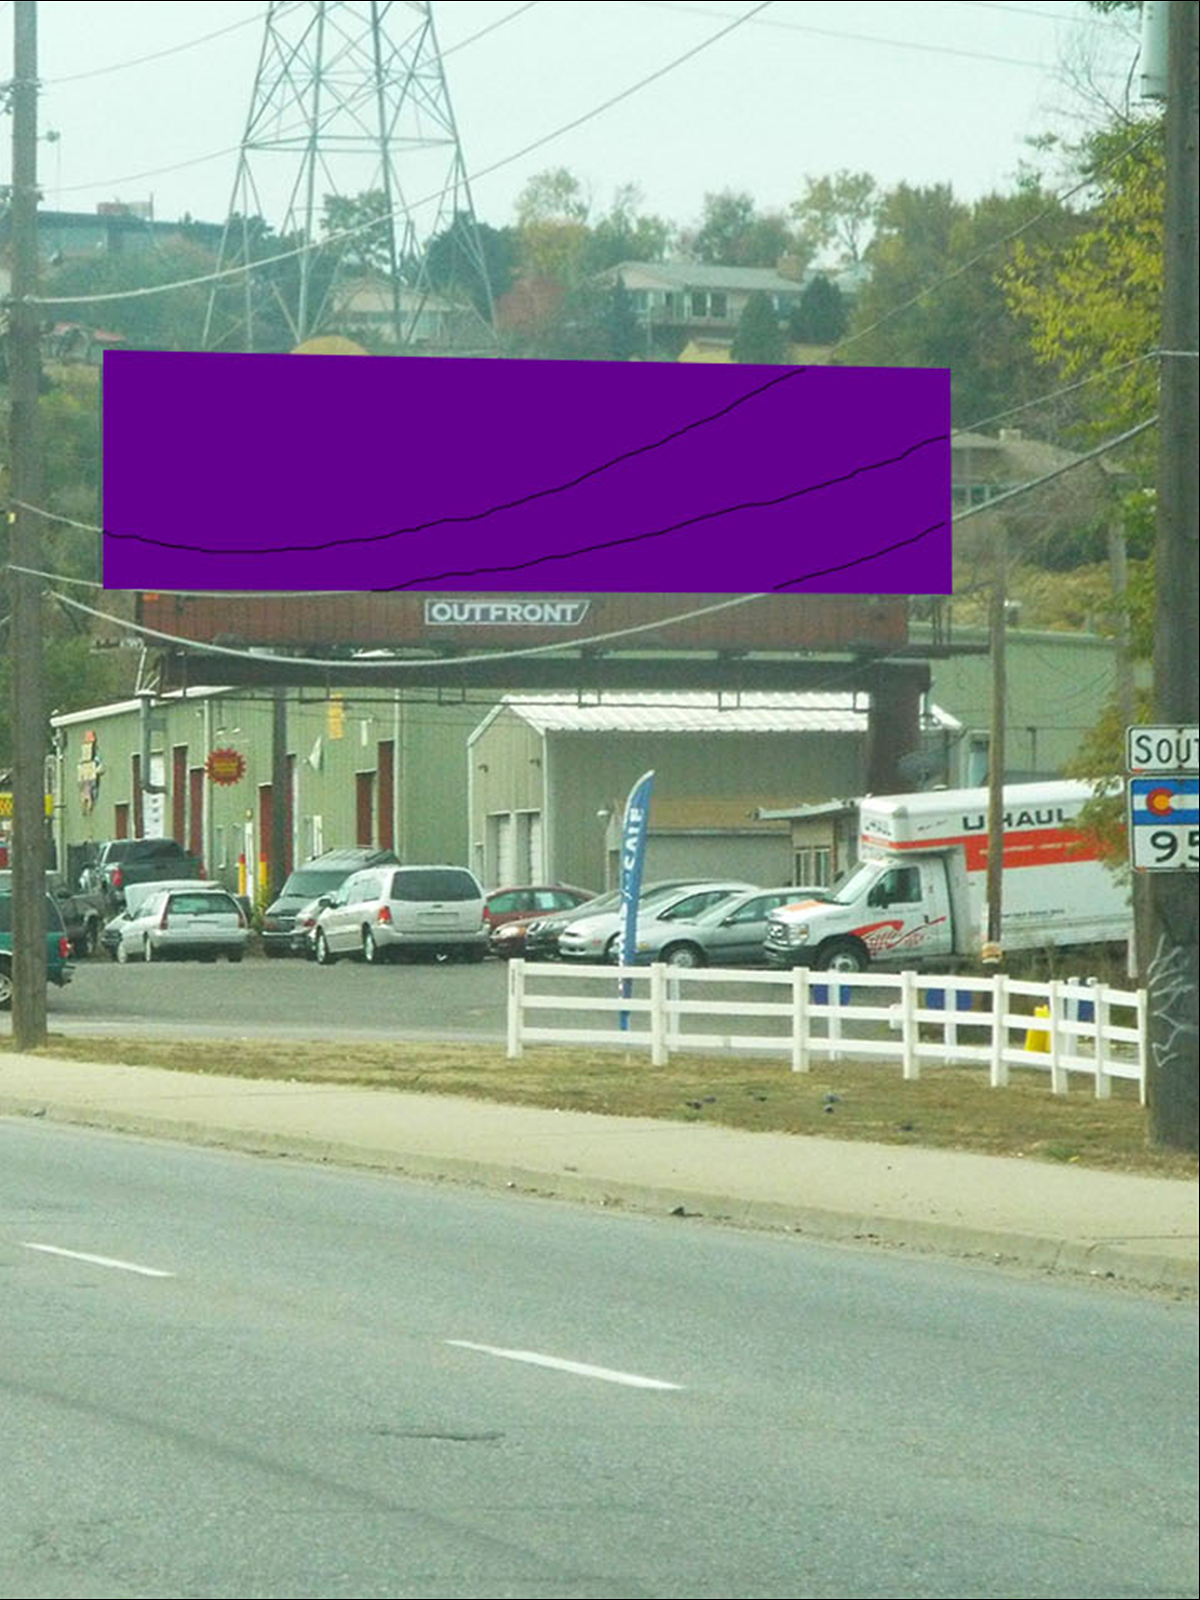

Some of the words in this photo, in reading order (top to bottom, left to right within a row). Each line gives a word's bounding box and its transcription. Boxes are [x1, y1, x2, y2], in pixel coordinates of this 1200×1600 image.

[431, 603, 578, 621] OUTFRONT
[1134, 734, 1199, 764] SOU
[962, 808, 1074, 831] UHAUL
